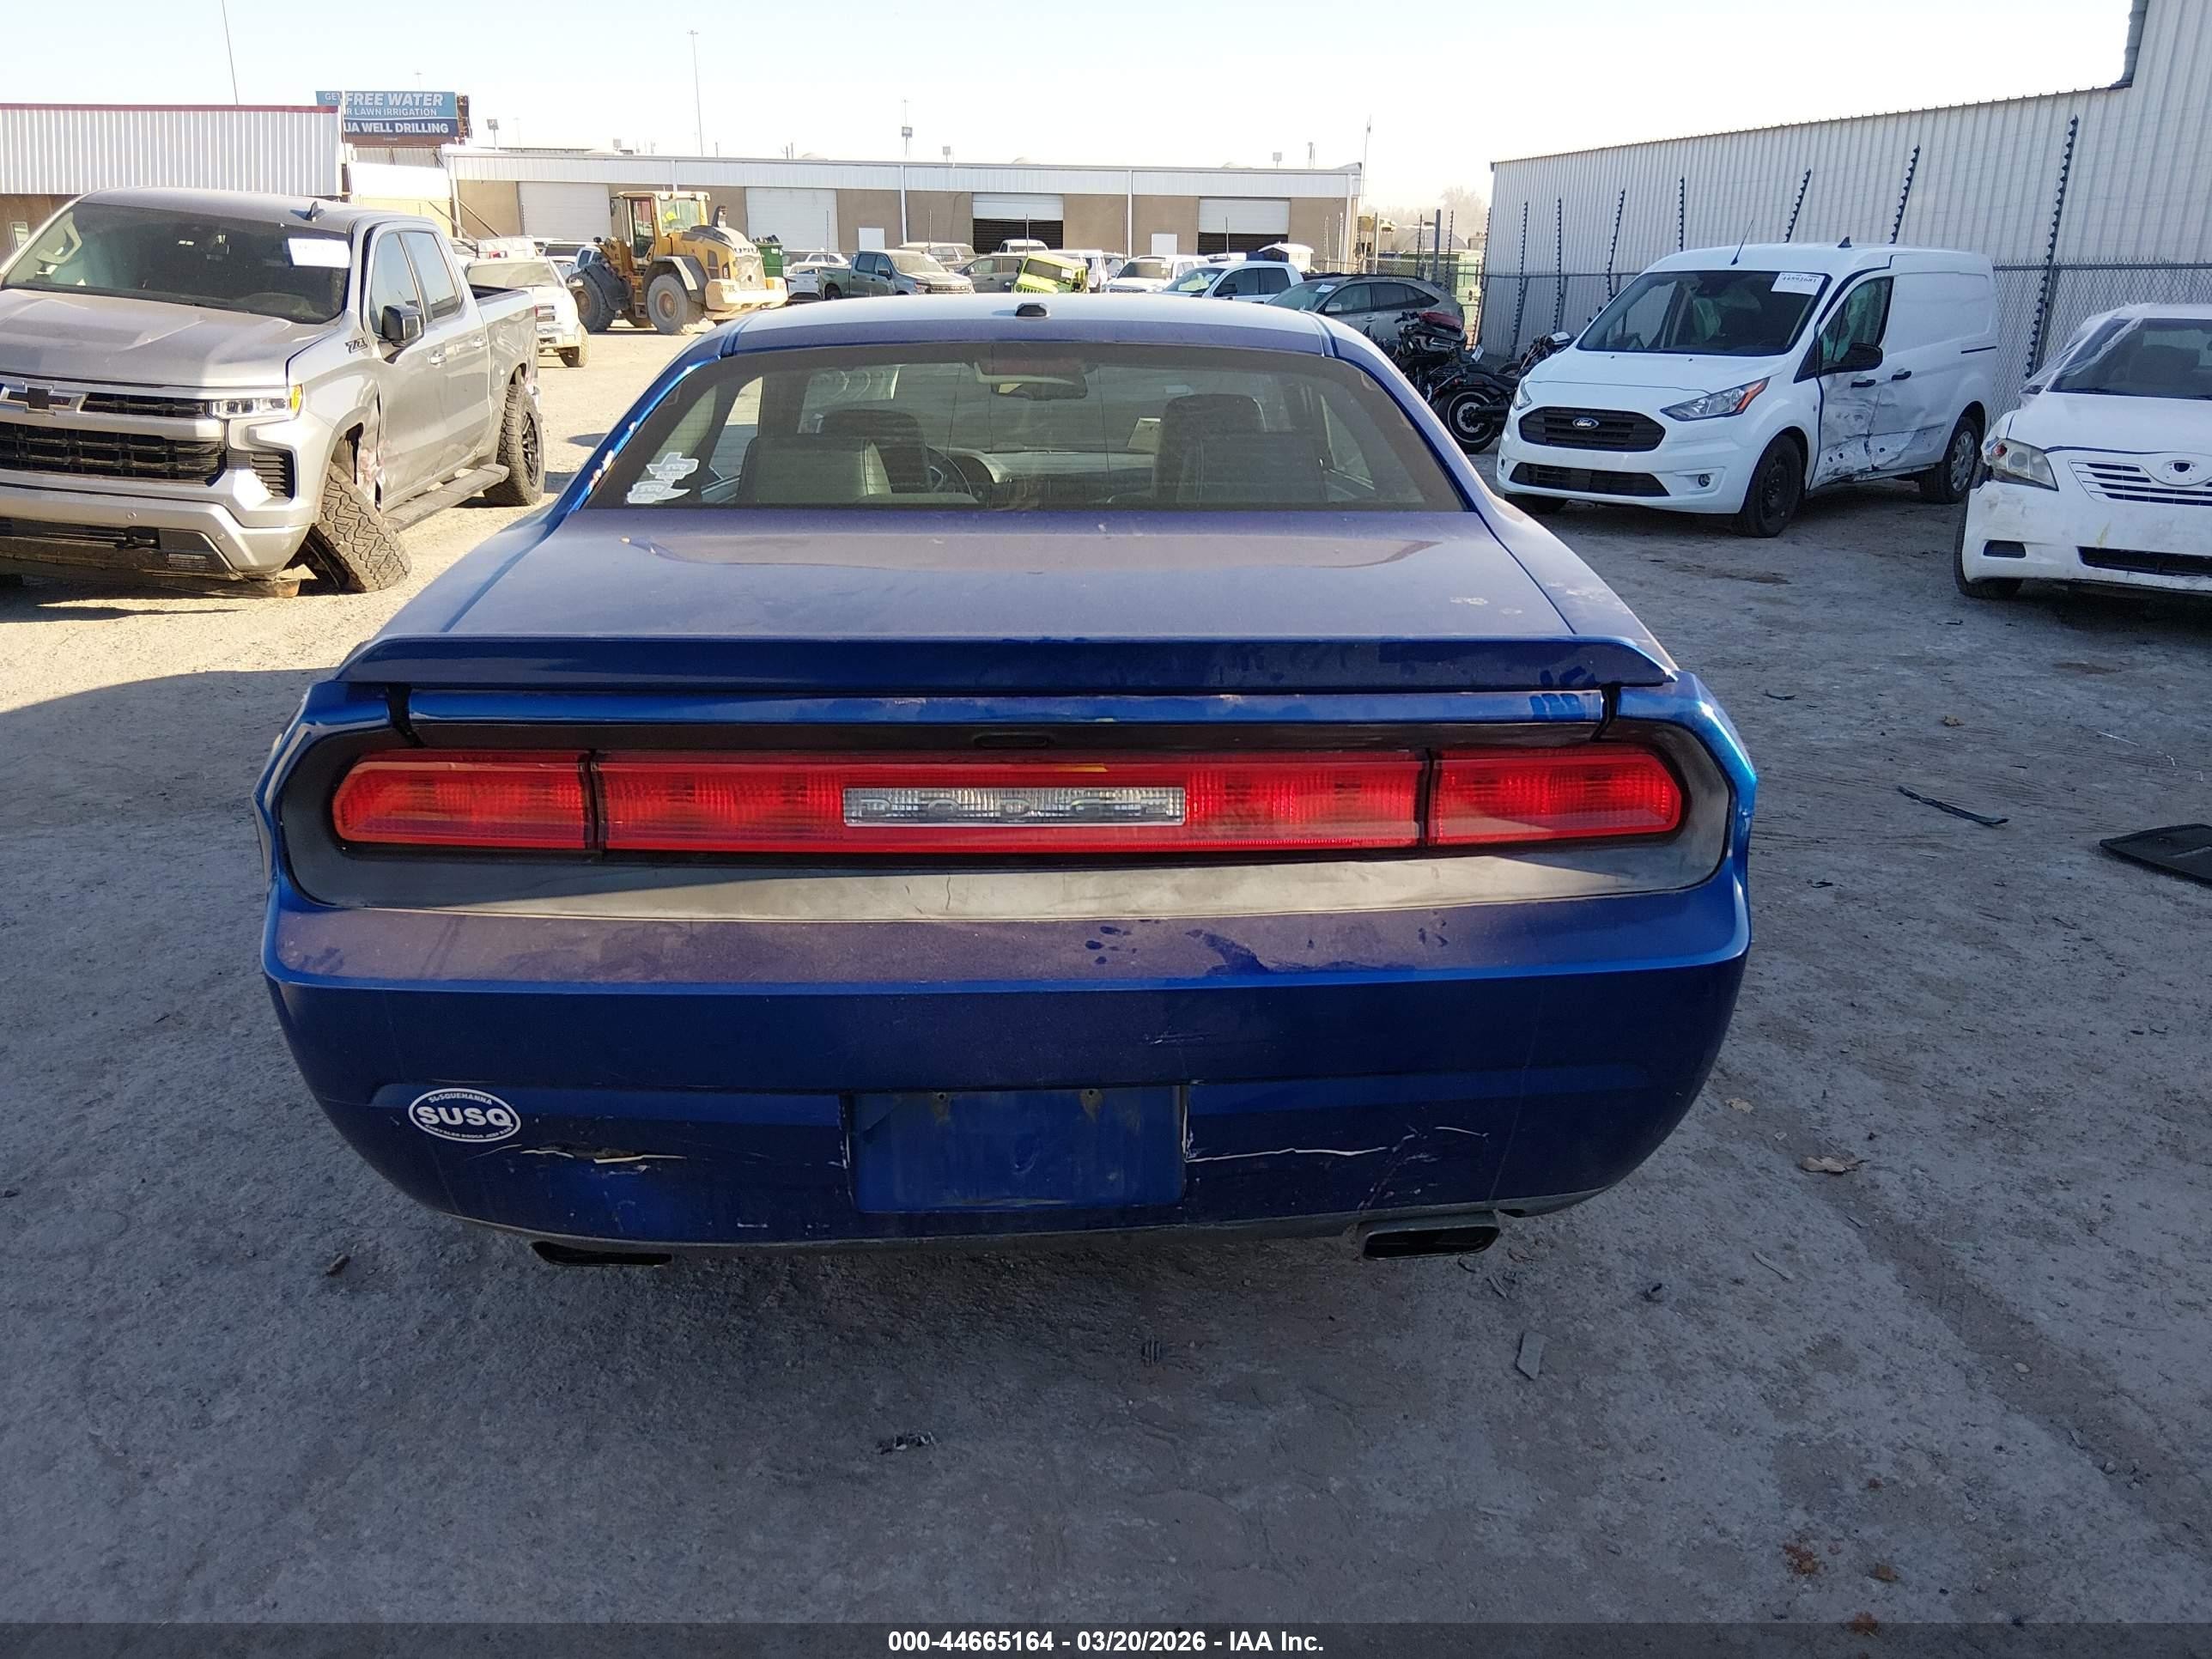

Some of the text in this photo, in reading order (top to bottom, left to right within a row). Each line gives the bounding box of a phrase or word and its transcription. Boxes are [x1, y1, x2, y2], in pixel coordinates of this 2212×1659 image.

[345, 93, 385, 106] FREE
[388, 93, 443, 106] WATER
[384, 108, 437, 117] IRRIGATION
[362, 122, 392, 133] WELL
[395, 122, 449, 134] DRILLING
[428, 1092, 492, 1105] SUSQUEHANNA
[416, 1107, 514, 1127] SUSQ
